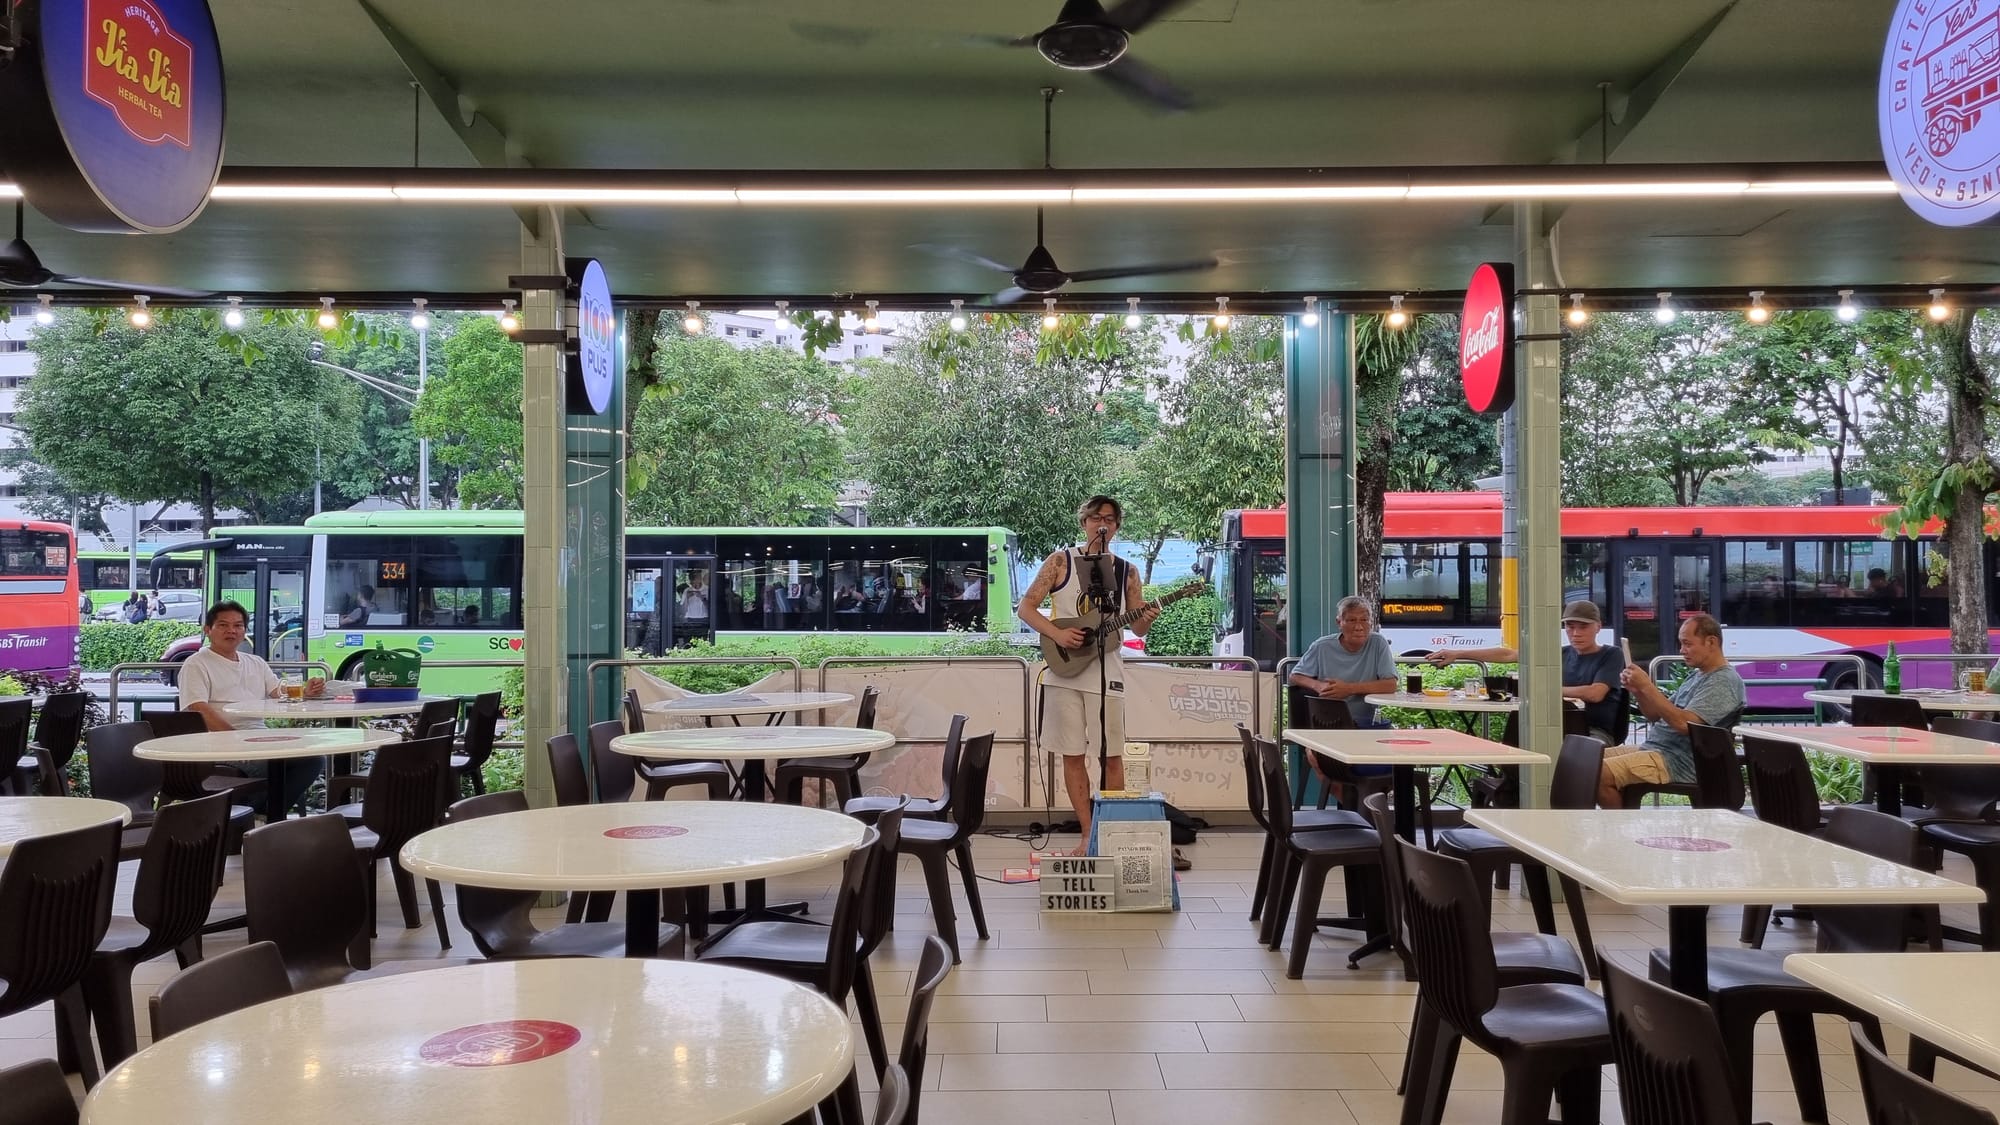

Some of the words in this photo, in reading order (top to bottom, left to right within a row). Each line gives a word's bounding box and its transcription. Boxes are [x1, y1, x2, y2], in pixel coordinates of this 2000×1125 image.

[124, 6, 161, 37] HERITAGE
[96, 19, 139, 83] Jia
[142, 48, 182, 108] Jia
[118, 86, 149, 111] HERBAL
[149, 103, 163, 120] TEA
[1905, 142, 1946, 198] YEO'S
[587, 348, 607, 378] PLUS
[382, 562, 405, 580] 334
[8, 633, 48, 650] Transit
[1431, 637, 1447, 646] SBS
[1443, 633, 1483, 646] Transit
[1053, 860, 1096, 874] @EVAN
[1063, 878, 1096, 892] TELL
[1047, 896, 1107, 909] STORIES
